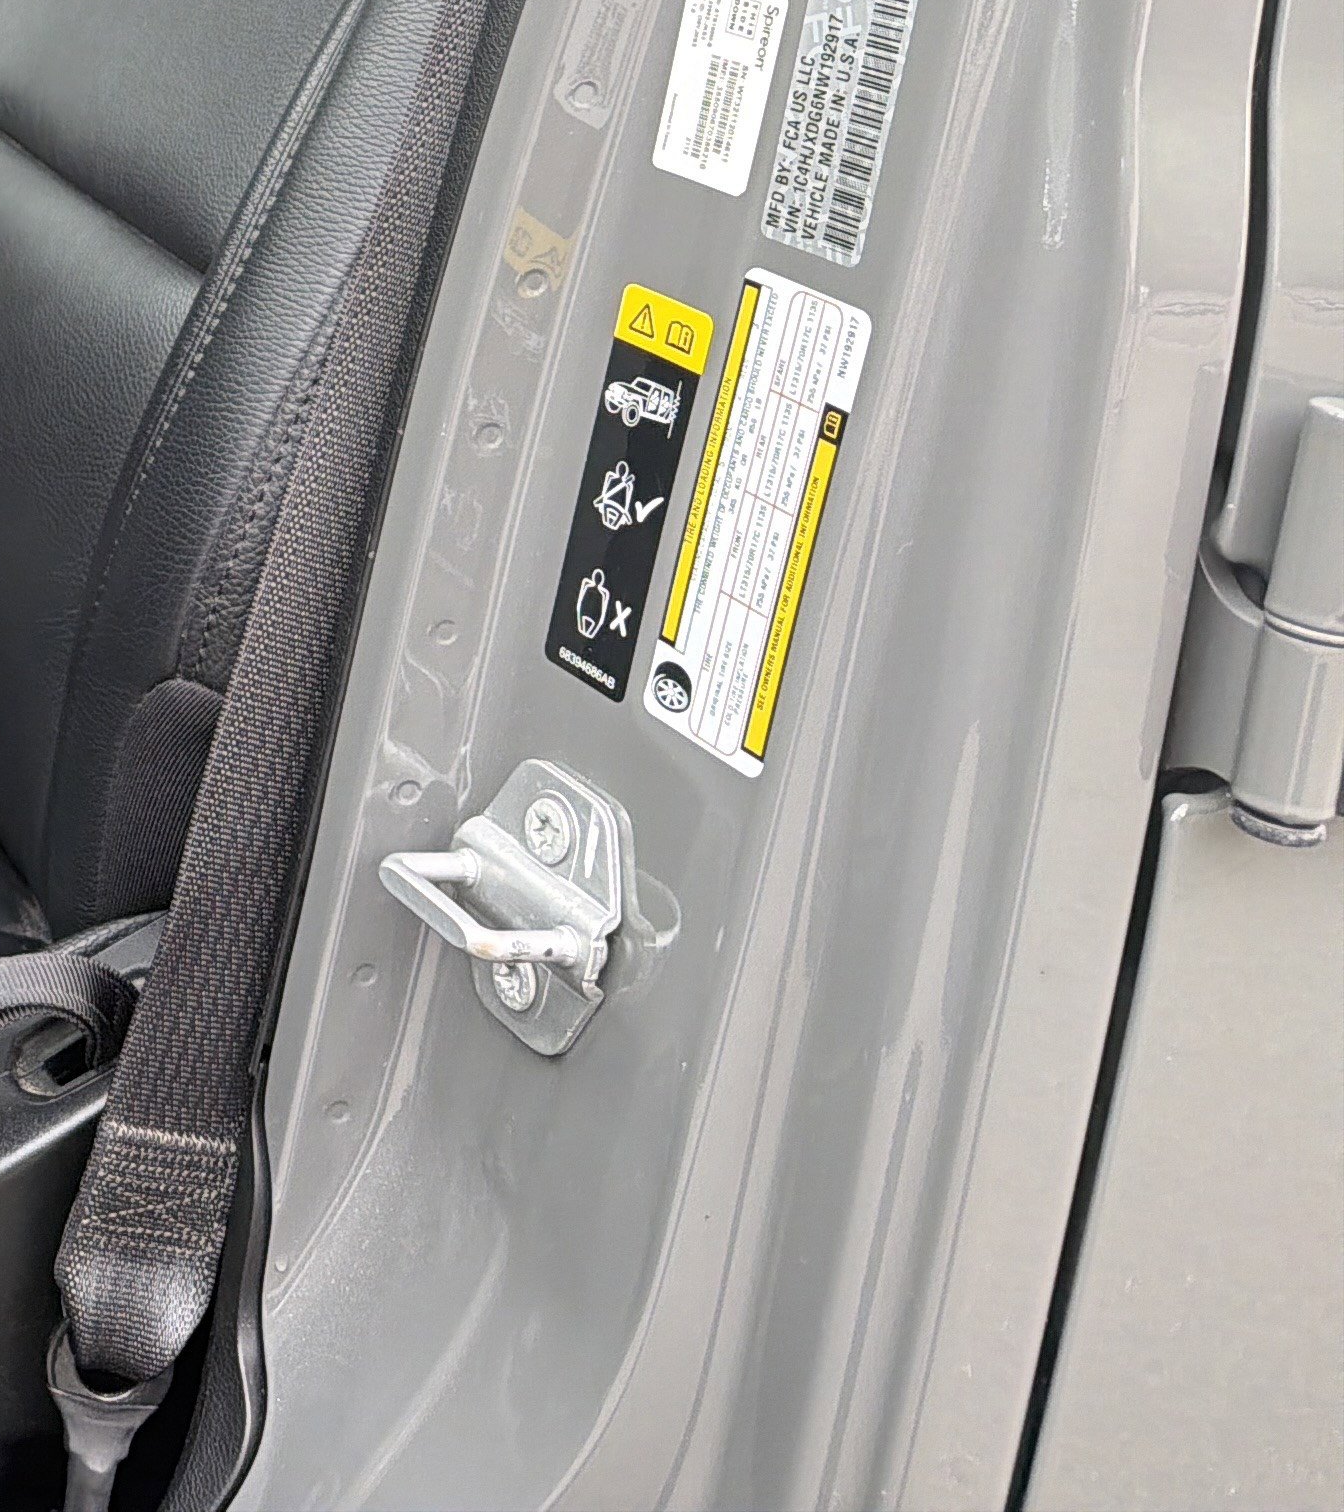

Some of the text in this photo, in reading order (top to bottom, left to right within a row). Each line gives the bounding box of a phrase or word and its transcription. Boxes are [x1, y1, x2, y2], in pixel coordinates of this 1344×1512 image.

[752, 3, 780, 71] Spireon
[795, 55, 816, 85] LLC
[781, 119, 802, 150] FCA
[789, 90, 808, 113] US
[789, 13, 845, 193] 1C4HJXDG6NW192917
[764, 189, 786, 228] MFD
[800, 170, 829, 242] VEHICLE
[816, 116, 841, 167] MADE
[696, 448, 714, 496] LOADING
[708, 374, 731, 449] INFORMATION
[755, 691, 766, 711] SEE
[770, 613, 786, 653] MANUAL
[780, 593, 790, 613] FOR
[785, 539, 804, 593] ADDITIONAL
[798, 474, 820, 538] INFORMATION
